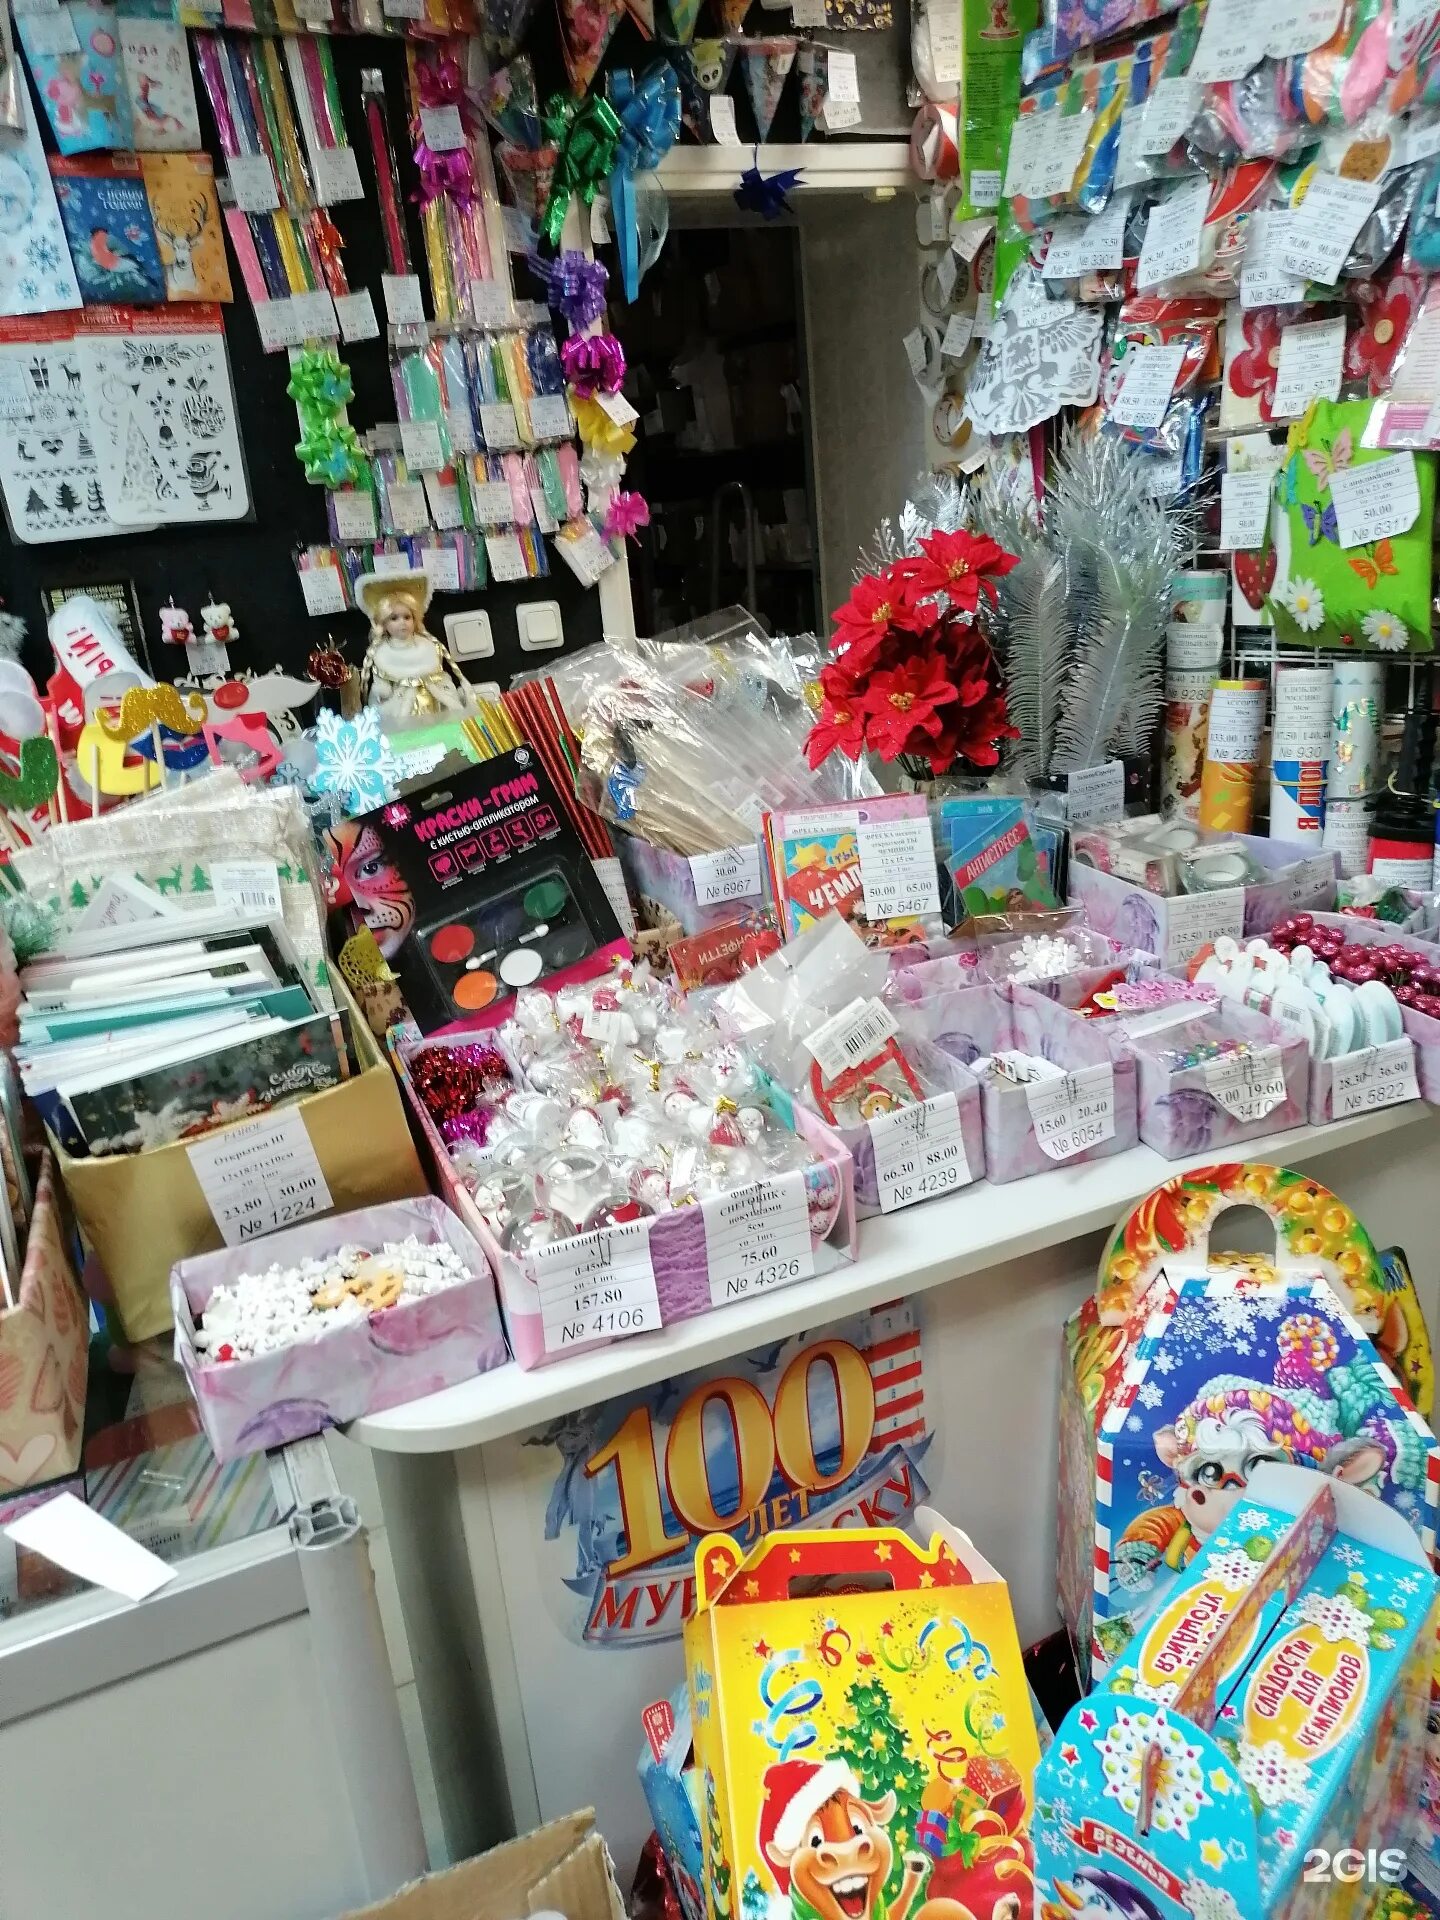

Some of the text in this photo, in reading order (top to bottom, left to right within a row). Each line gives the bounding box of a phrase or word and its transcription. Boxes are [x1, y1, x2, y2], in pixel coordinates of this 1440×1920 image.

[965, 827, 1022, 882] АНТИСТРЕСС
[706, 879, 751, 900] № 6967
[869, 881, 932, 898] 50.00 65.00
[877, 898, 929, 916] № 5467
[1248, 1080, 1284, 1098] 19.60
[1344, 1082, 1405, 1112] № 5822
[1039, 1100, 1108, 1135] 15.60 20.40
[1052, 1121, 1104, 1155] № 6054
[883, 1145, 959, 1183] 66.30 88.00
[893, 1166, 958, 1204] № 4239
[222, 1197, 263, 1221] 23.80
[239, 1195, 317, 1239] № 1224
[719, 1189, 780, 1217] СНЕГОВИК
[538, 1230, 606, 1258] СНЕГОВИК
[740, 1245, 778, 1268] 75.60
[726, 1258, 800, 1298] № 4326
[574, 1288, 623, 1312] 157.80
[562, 1308, 645, 1344] № 4106
[584, 1340, 876, 1578] 100
[744, 1484, 816, 1539] ЛЕТ
[1154, 1592, 1224, 1674] УГОЩАЙСЯ
[1253, 1638, 1314, 1719] СЛАДОСТИ
[1290, 1668, 1325, 1707] ДЛЯ
[1297, 1653, 1362, 1748] ЧЕМПИОНОВ
